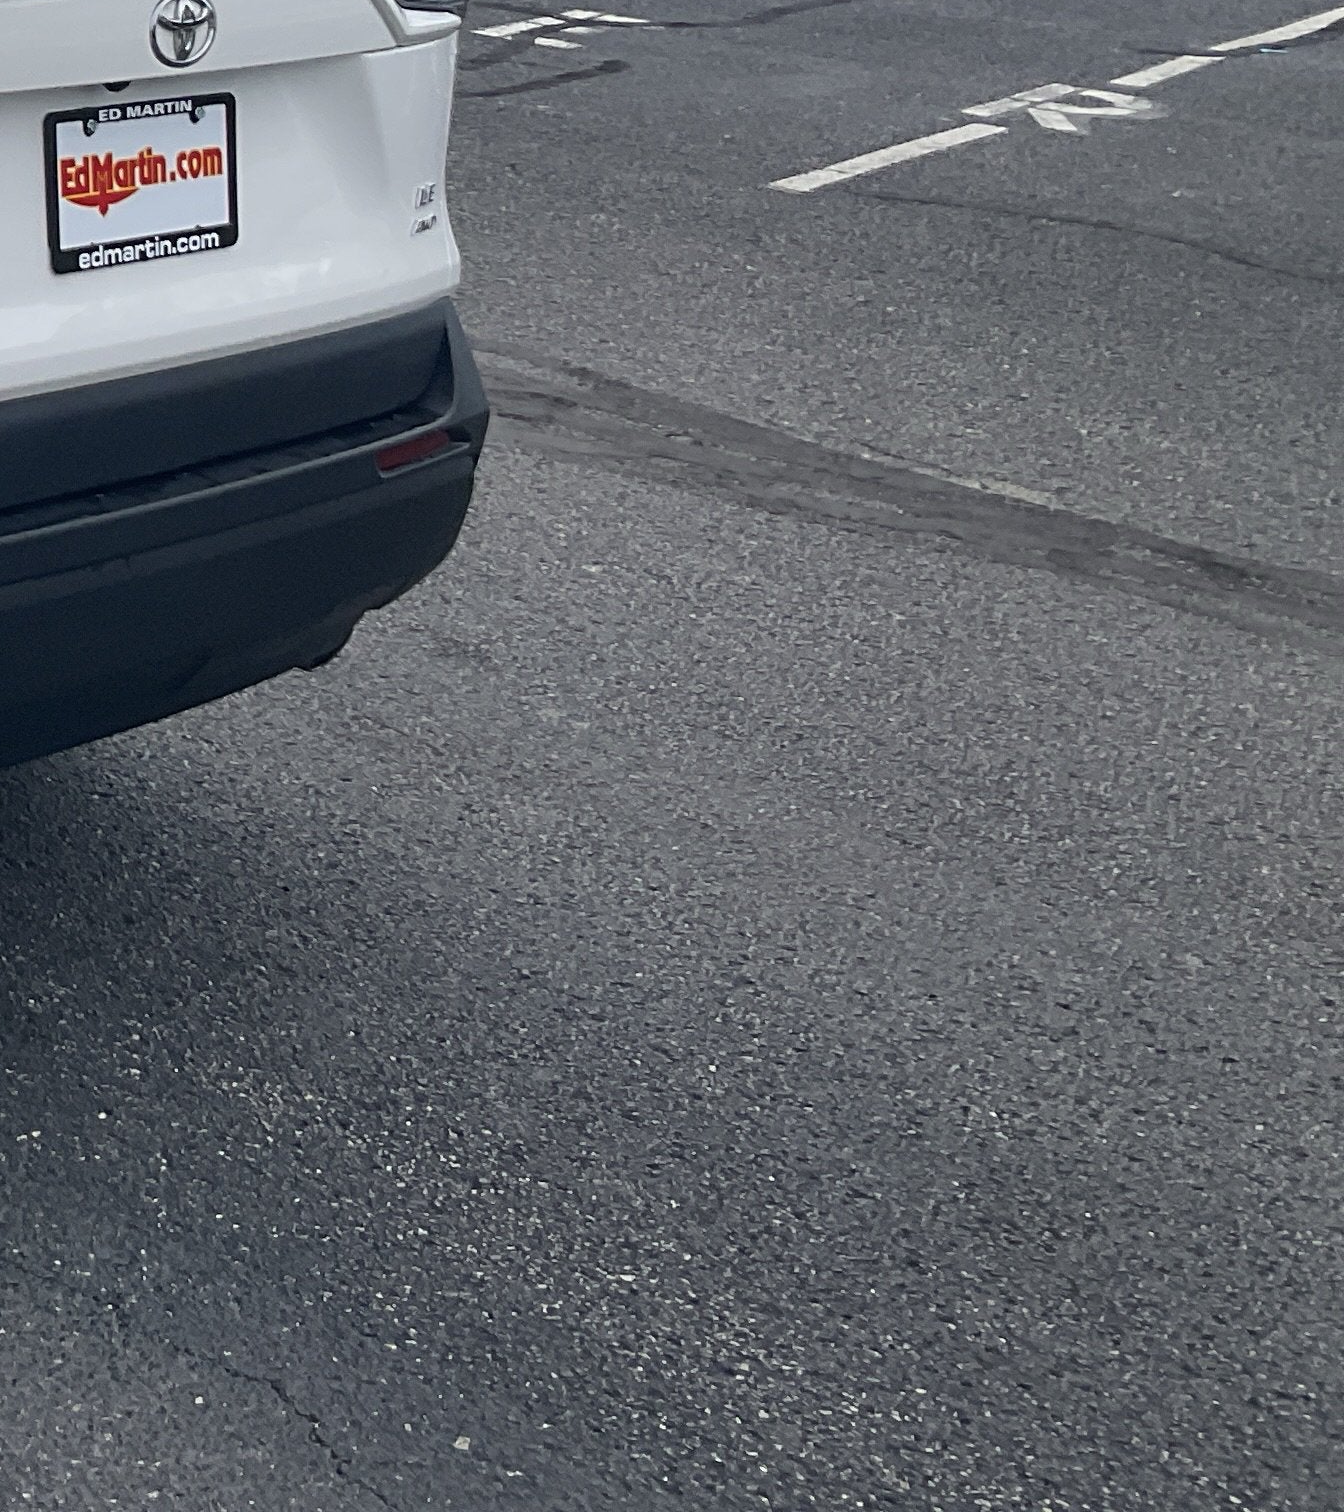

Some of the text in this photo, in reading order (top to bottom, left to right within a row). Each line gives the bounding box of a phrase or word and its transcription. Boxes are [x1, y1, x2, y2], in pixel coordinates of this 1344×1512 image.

[98, 99, 193, 123] ED MARTIN
[78, 231, 220, 270] edmartin.com
